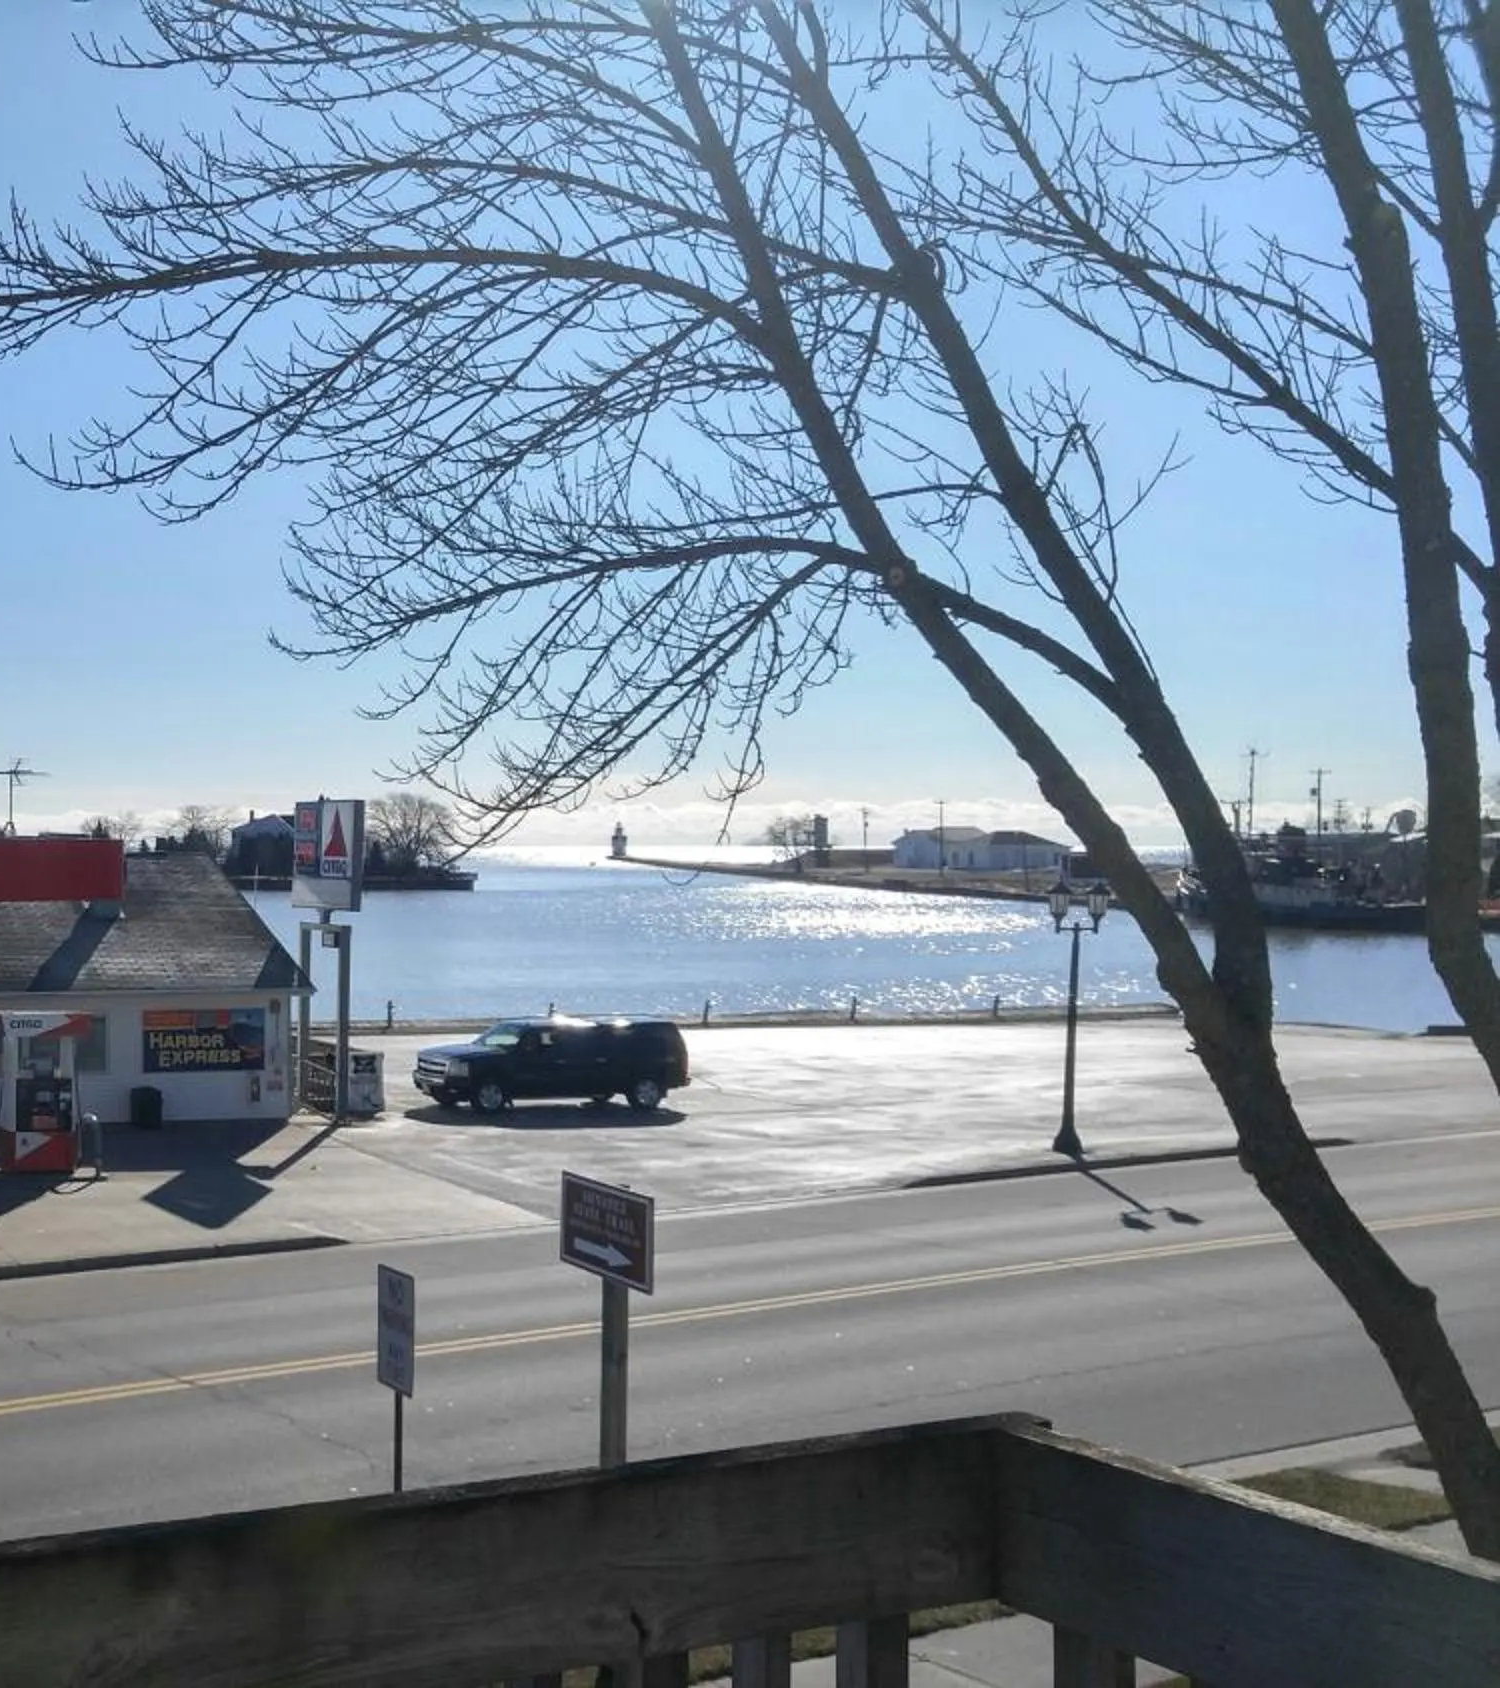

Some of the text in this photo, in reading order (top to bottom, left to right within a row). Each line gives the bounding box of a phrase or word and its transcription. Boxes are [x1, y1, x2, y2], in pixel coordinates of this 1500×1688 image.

[10, 1019, 43, 1030] CITGO
[149, 1030, 225, 1049] HARBOR
[158, 1048, 242, 1068] EXPRESS
